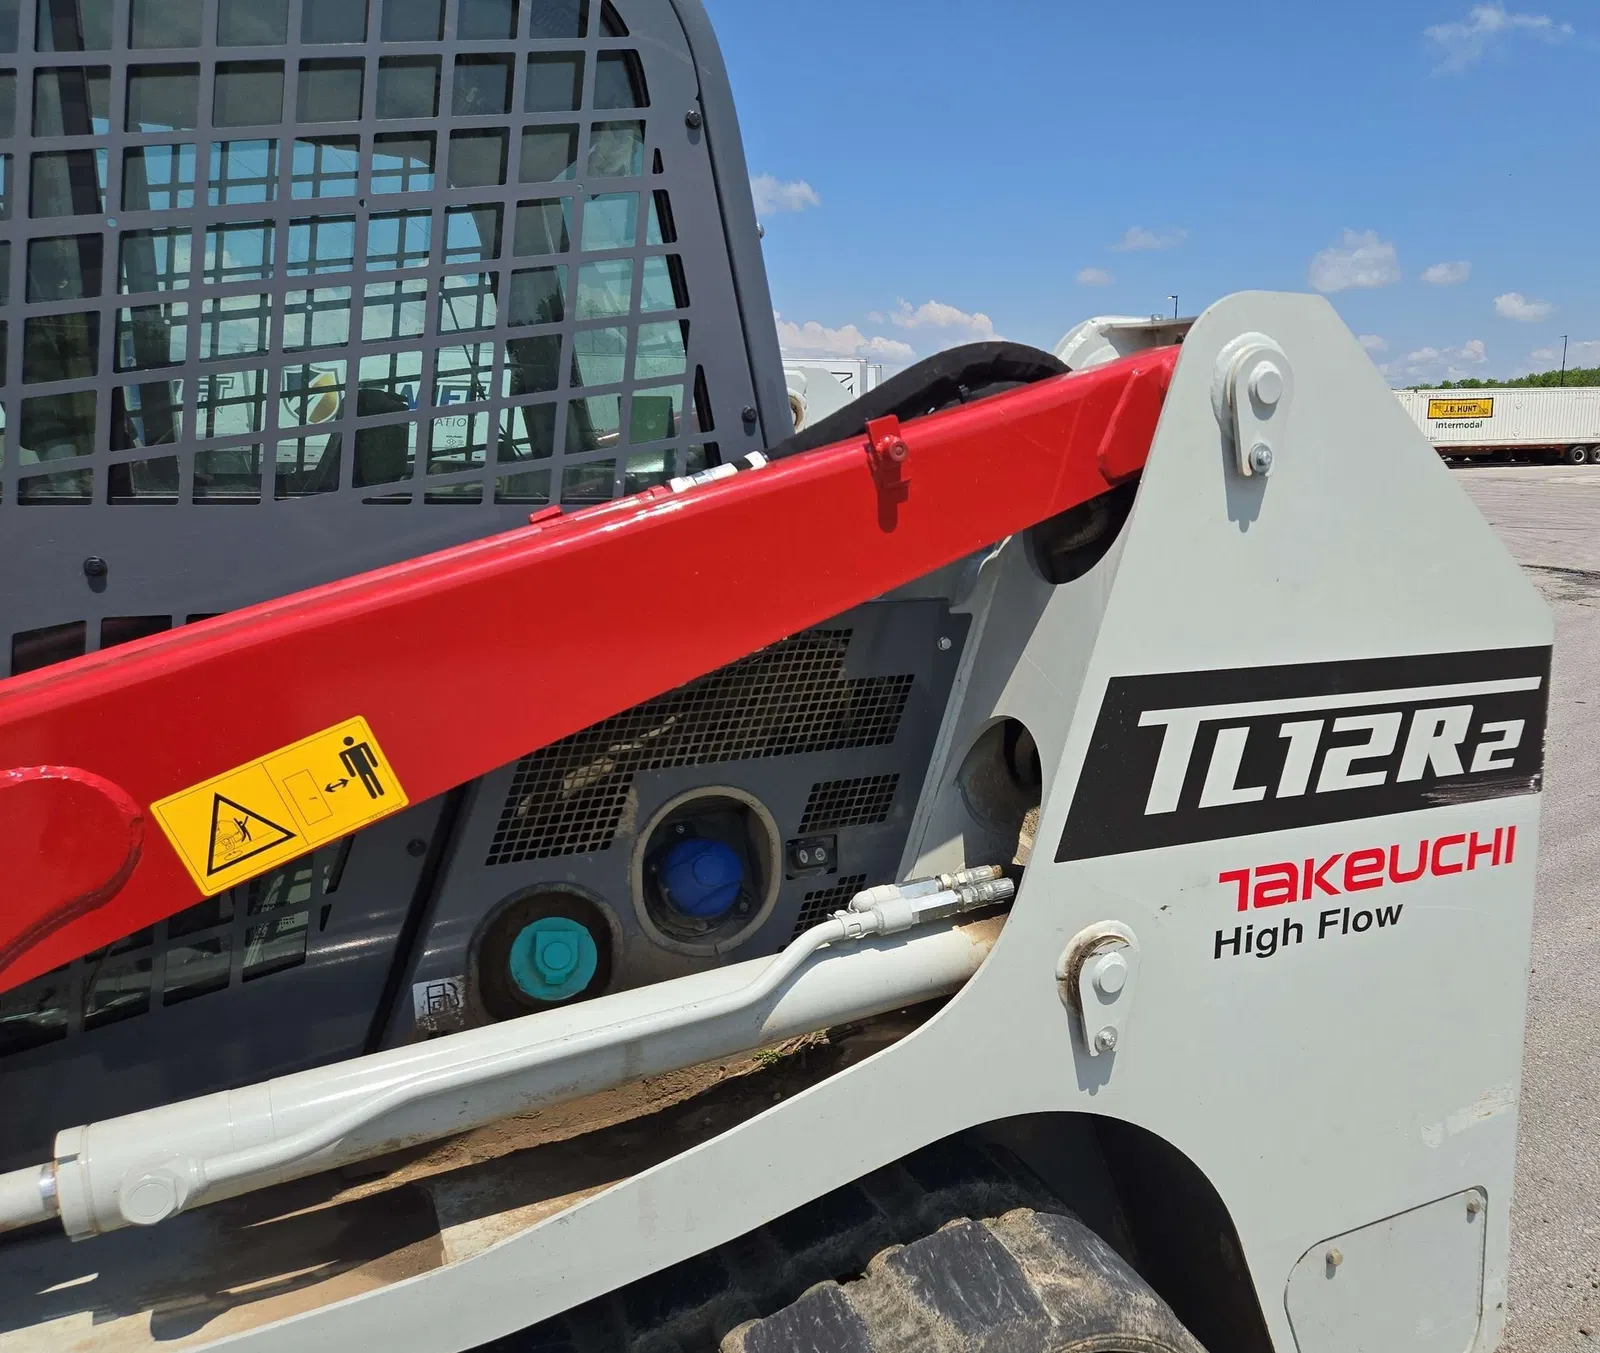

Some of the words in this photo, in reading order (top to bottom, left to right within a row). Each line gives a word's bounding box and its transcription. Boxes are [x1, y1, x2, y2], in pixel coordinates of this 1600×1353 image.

[1435, 420, 1483, 429] Intermodal
[1457, 404, 1477, 412] HUNT
[1137, 676, 1542, 816] TL12R2
[1213, 918, 1304, 960] High
[1318, 903, 1404, 940] Flow
